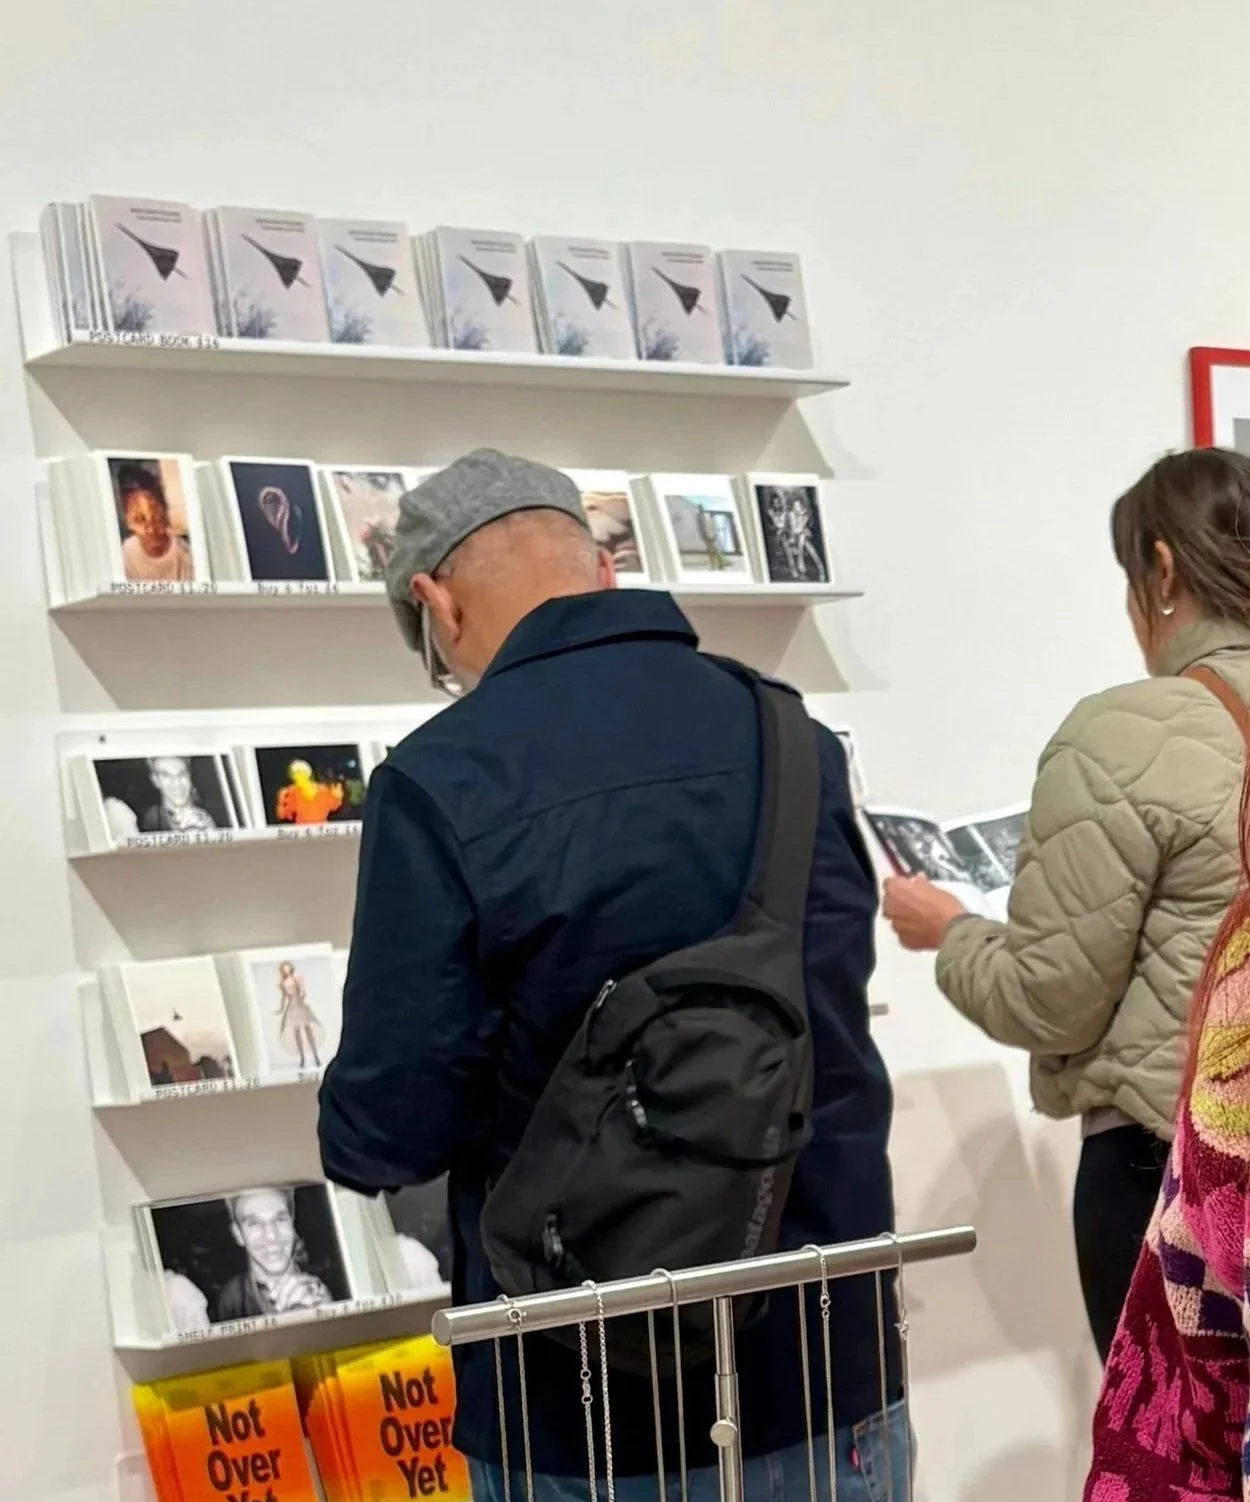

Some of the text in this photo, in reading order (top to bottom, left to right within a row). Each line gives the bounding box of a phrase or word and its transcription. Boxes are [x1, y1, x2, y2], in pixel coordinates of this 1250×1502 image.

[110, 582, 174, 595] POSTCARD
[127, 834, 190, 848] POSTCARD
[155, 1083, 218, 1100] POSTCARD
[178, 1327, 213, 1344] SHELF
[220, 1320, 257, 1336] PRINT
[378, 1365, 440, 1412] Not
[205, 1398, 266, 1446] Not
[380, 1415, 451, 1458] Over
[207, 1448, 282, 1493] Over
[397, 1450, 449, 1499] Yet
